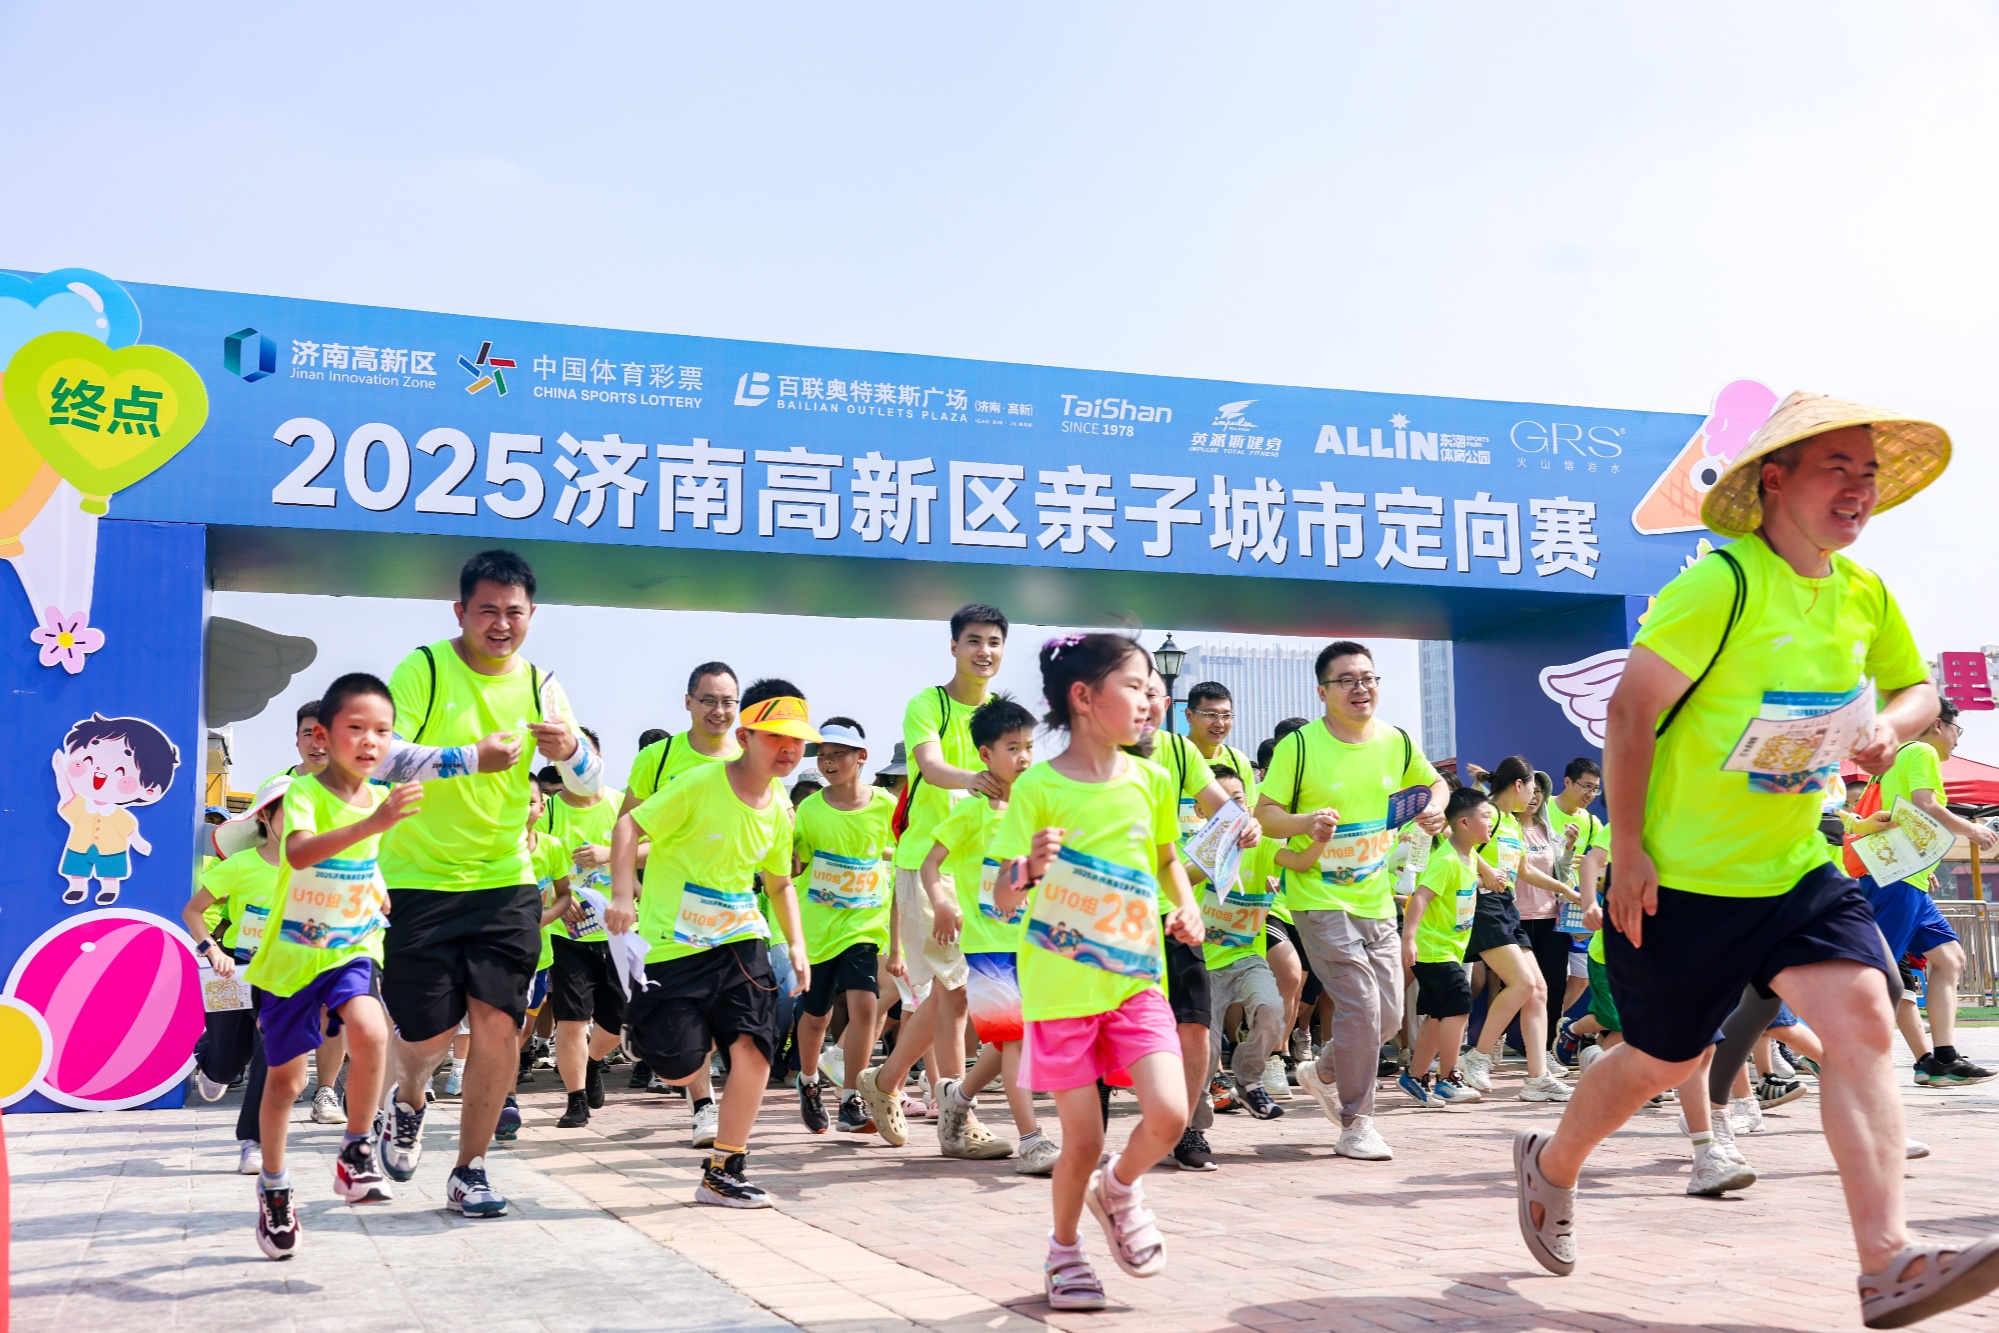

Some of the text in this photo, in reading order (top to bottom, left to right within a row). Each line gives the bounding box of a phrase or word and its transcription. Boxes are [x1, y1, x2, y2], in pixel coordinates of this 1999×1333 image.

[291, 339, 437, 376] 济南高新区
[290, 367, 436, 389] Jinan Innovation Zone
[533, 353, 703, 391] 中国体育彩票
[533, 386, 702, 409] CHINA SPORTS LOTTERY
[777, 375, 968, 411] 百联奥特莱斯广场
[49, 376, 164, 438] 终点
[777, 400, 968, 423] BAILIAN OUTLETS PLAZA
[1061, 393, 1173, 424] TaiShan
[1061, 420, 1135, 437] SINCE 1978
[1188, 446, 1219, 454] IMPULSE
[1249, 450, 1280, 458] FITNESS
[1190, 431, 1282, 451] 英派斯健身
[1440, 447, 1491, 465] 体育公园
[271, 417, 1601, 580] 2025济南高新区亲子城市定向赛
[813, 870, 842, 885] U10组
[839, 870, 879, 893] 259
[292, 886, 343, 909] U10组
[681, 908, 718, 927] U10组
[1044, 882, 1158, 948] U10组 28
[1203, 904, 1234, 922] U10组
